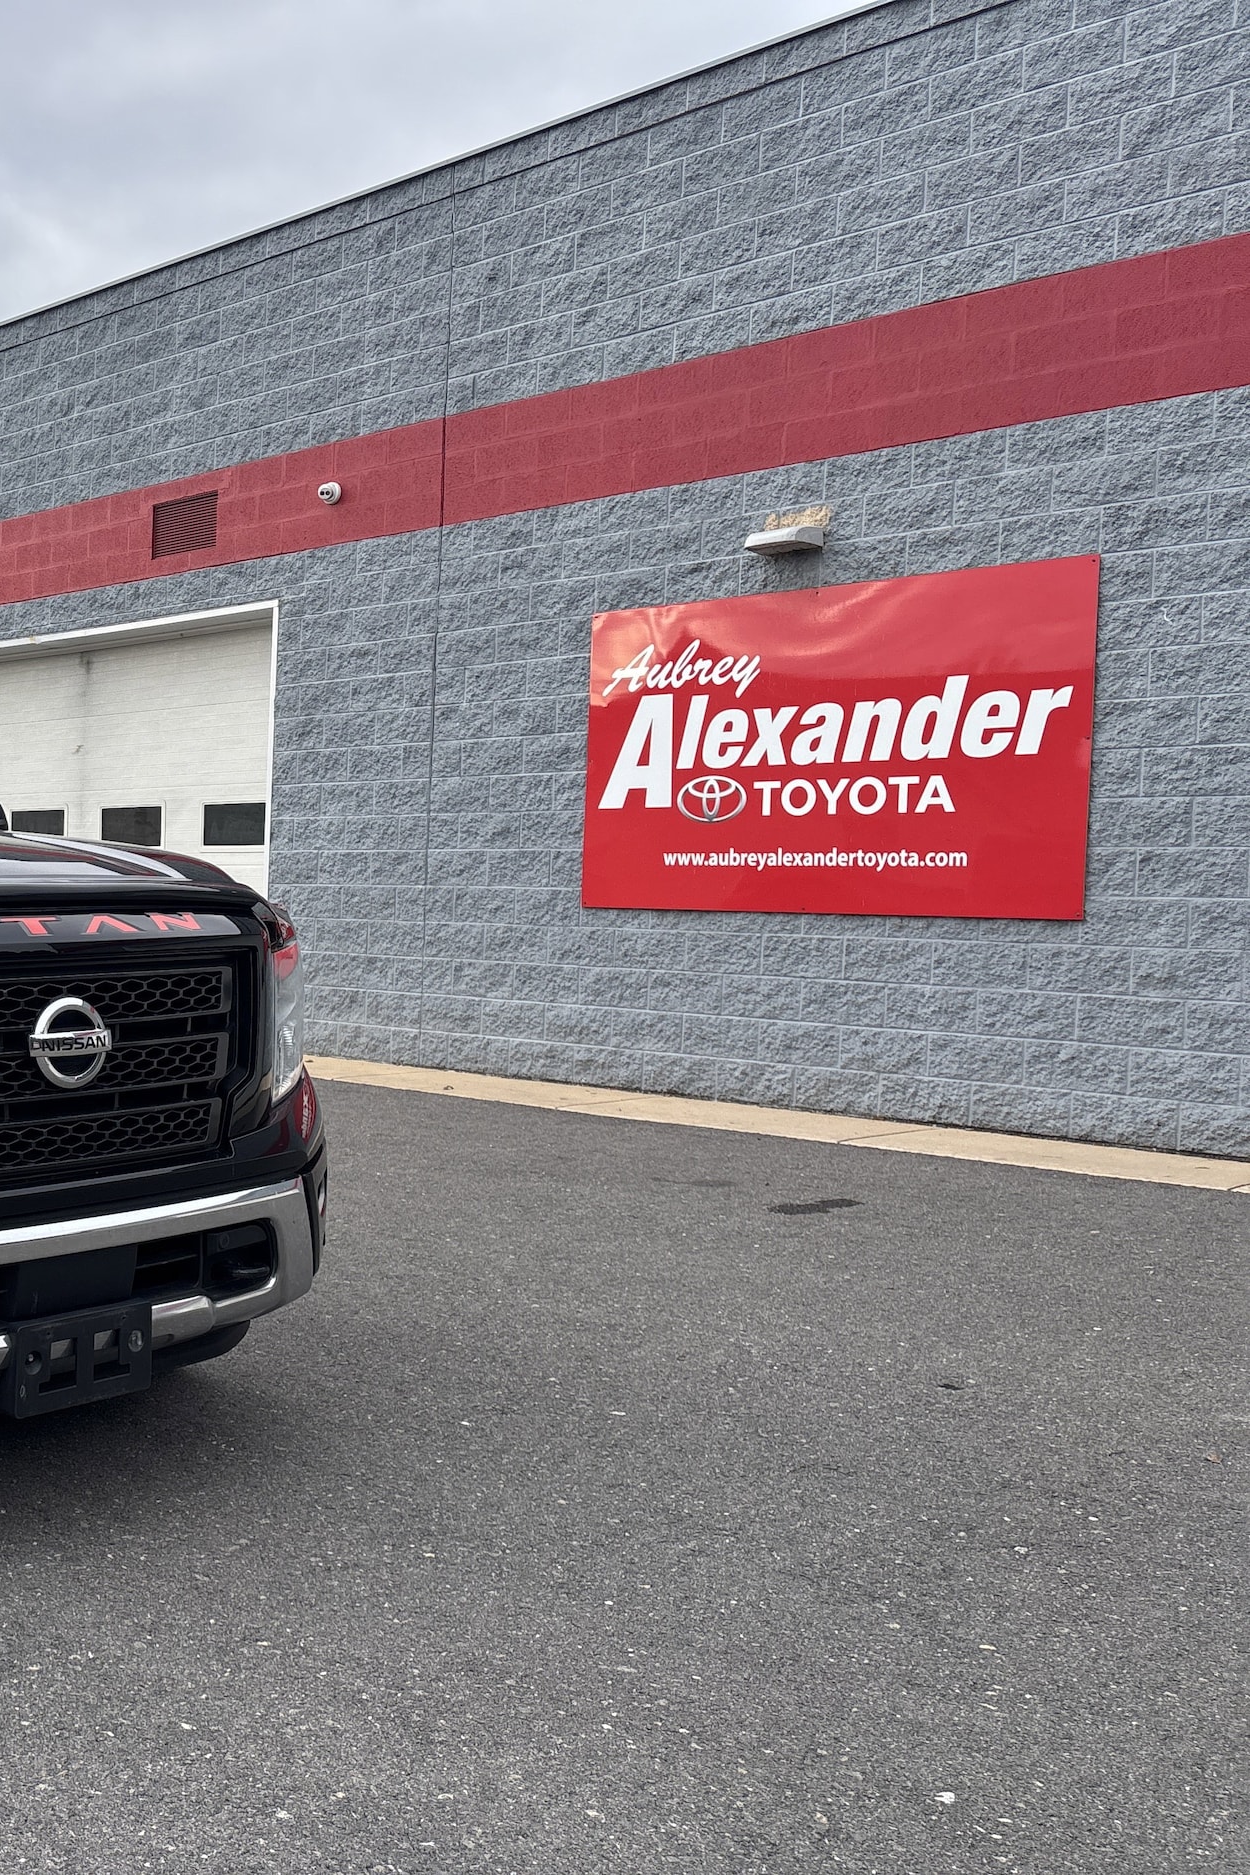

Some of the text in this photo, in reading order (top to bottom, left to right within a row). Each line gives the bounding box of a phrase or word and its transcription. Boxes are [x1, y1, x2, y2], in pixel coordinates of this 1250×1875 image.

[602, 639, 760, 698] Aubrey
[598, 674, 1074, 810] Alexander
[753, 775, 955, 817] TOYOTA
[662, 847, 968, 873] www.aubreyalexandertoyota.com
[41, 1035, 106, 1052] NISSAN
